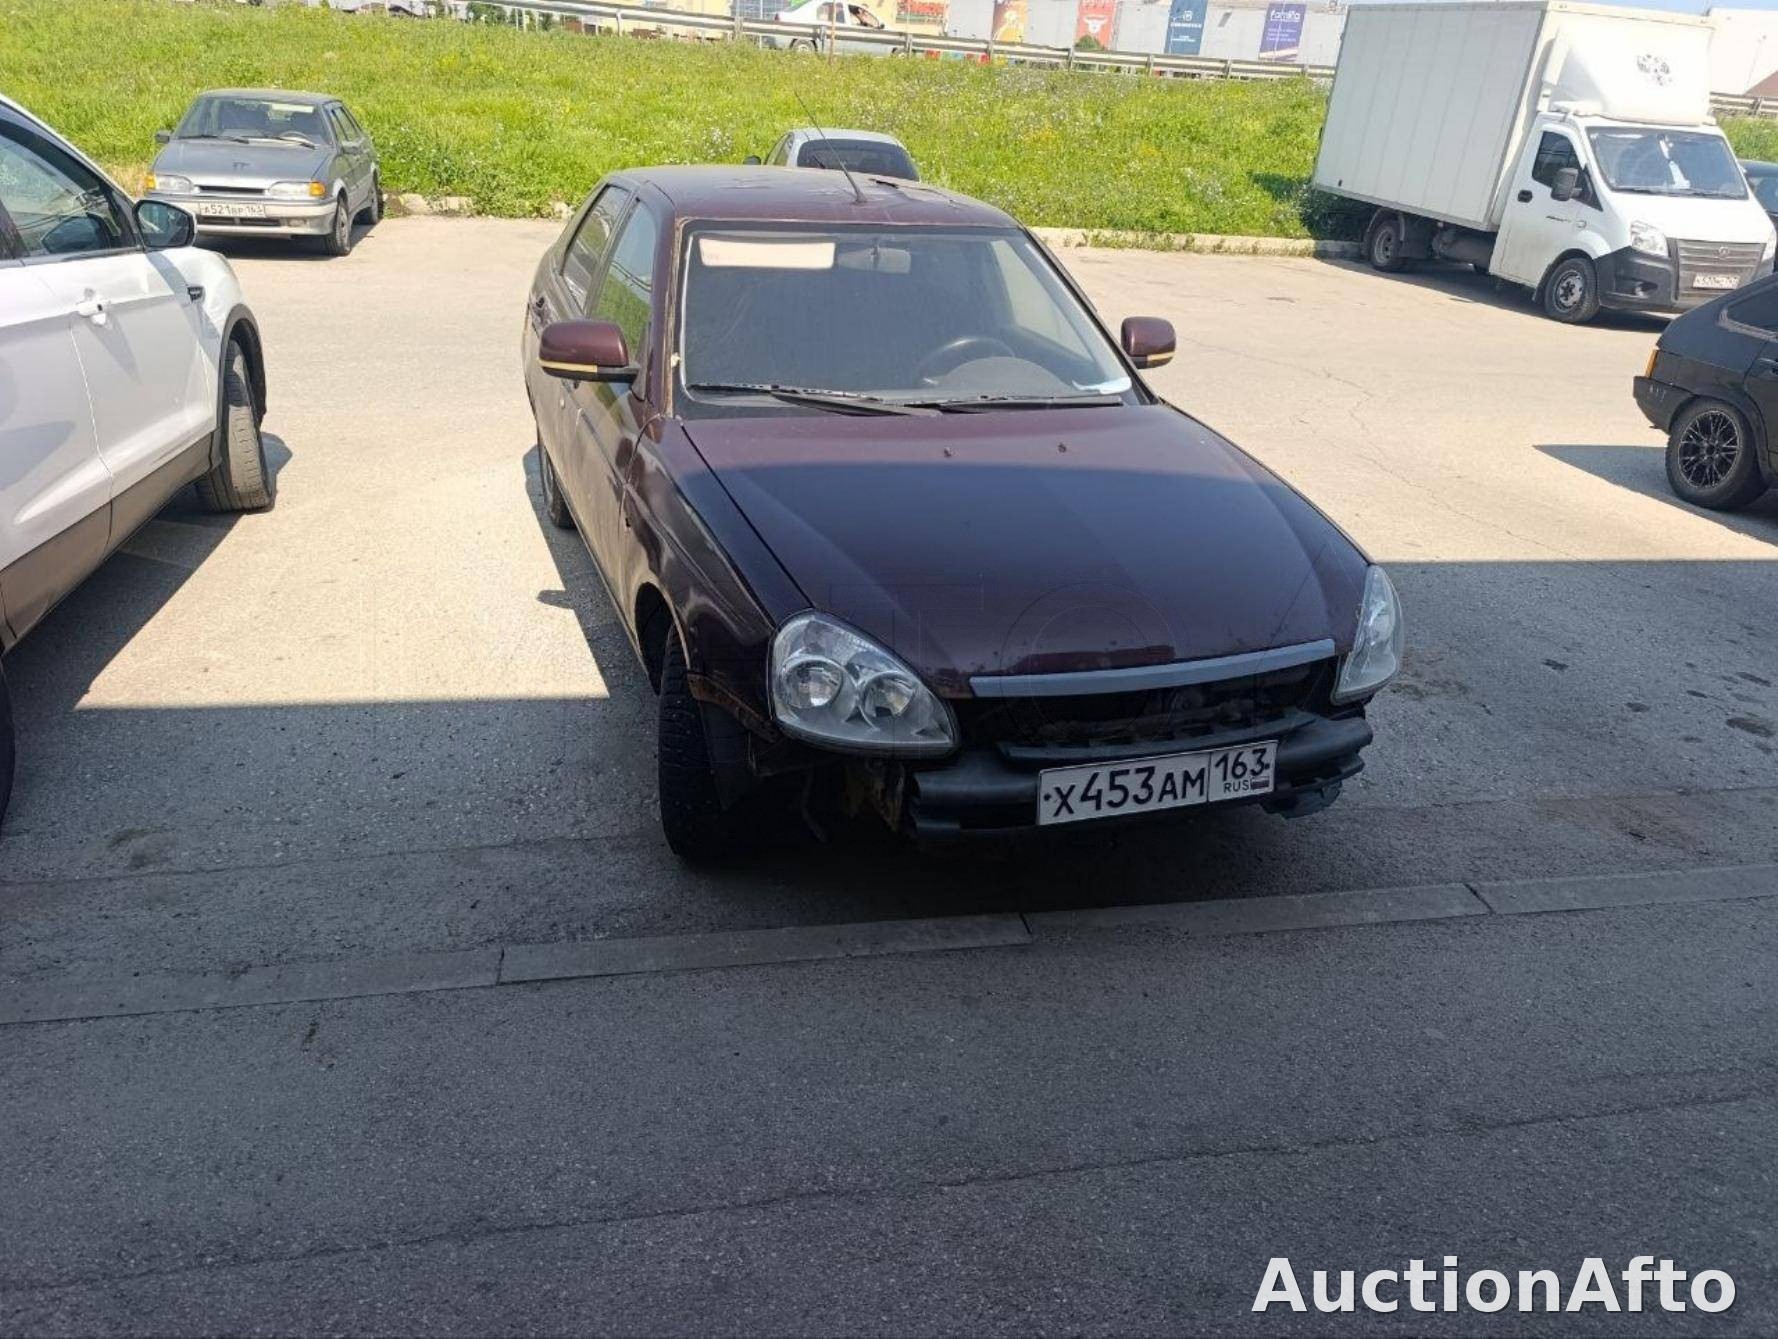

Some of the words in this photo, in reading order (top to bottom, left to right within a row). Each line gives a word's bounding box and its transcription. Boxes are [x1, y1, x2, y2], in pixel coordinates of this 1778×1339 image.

[1052, 766, 1206, 818] Х453АМ
[1214, 748, 1267, 781] 163
[1223, 780, 1250, 793] RUS
